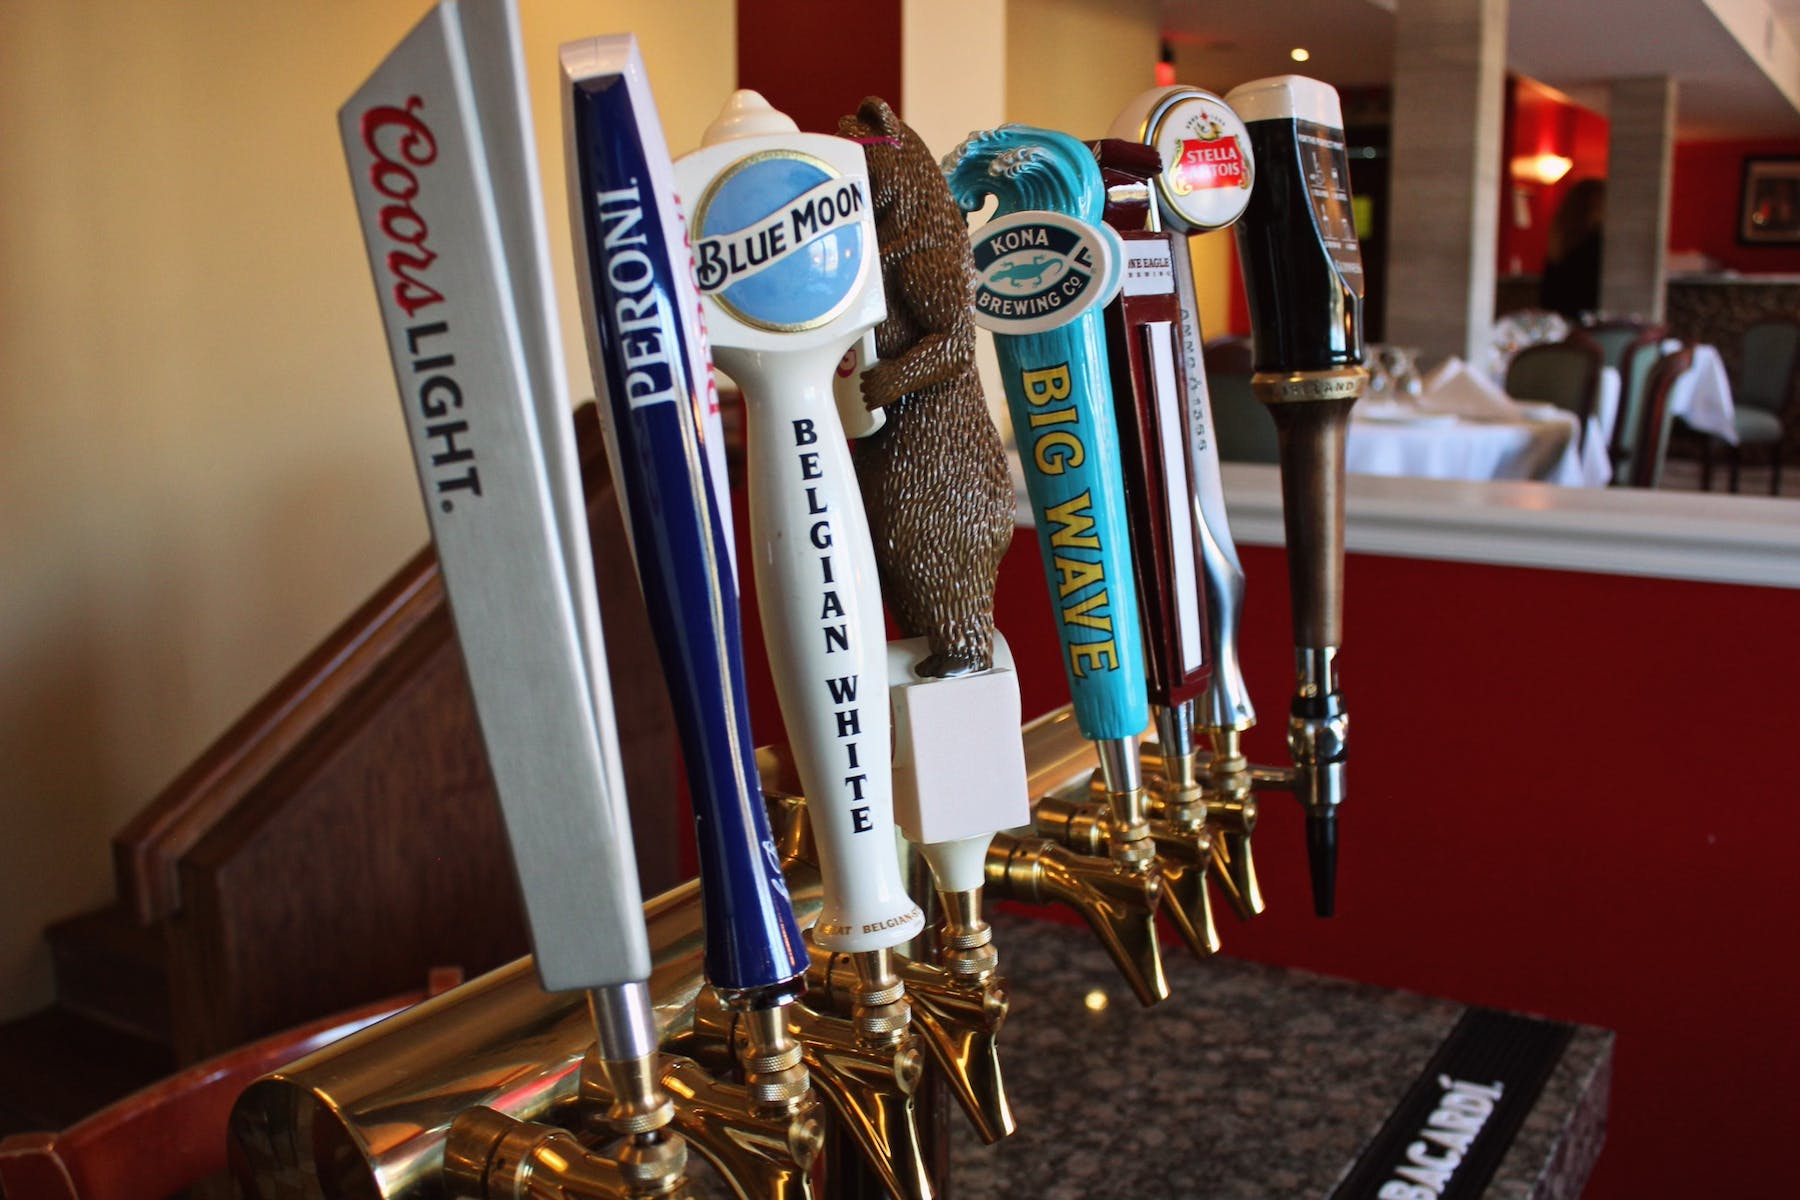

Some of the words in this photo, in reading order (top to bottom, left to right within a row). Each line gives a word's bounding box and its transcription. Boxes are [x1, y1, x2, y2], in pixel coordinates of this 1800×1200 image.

[360, 94, 445, 319] Coors
[1187, 148, 1237, 163] STELLA
[696, 222, 787, 291] BLUE
[791, 181, 866, 244] MOON
[990, 228, 1049, 256] KONA
[1143, 257, 1169, 268] EAGLE
[977, 292, 1061, 316] BREWING
[406, 321, 482, 497] LIGHT
[1021, 360, 1085, 477] BIG
[1282, 381, 1354, 396] IRLAND
[792, 419, 850, 654] BELGIAN
[826, 675, 873, 834] WHITE
[1044, 487, 1120, 680] WAVE
